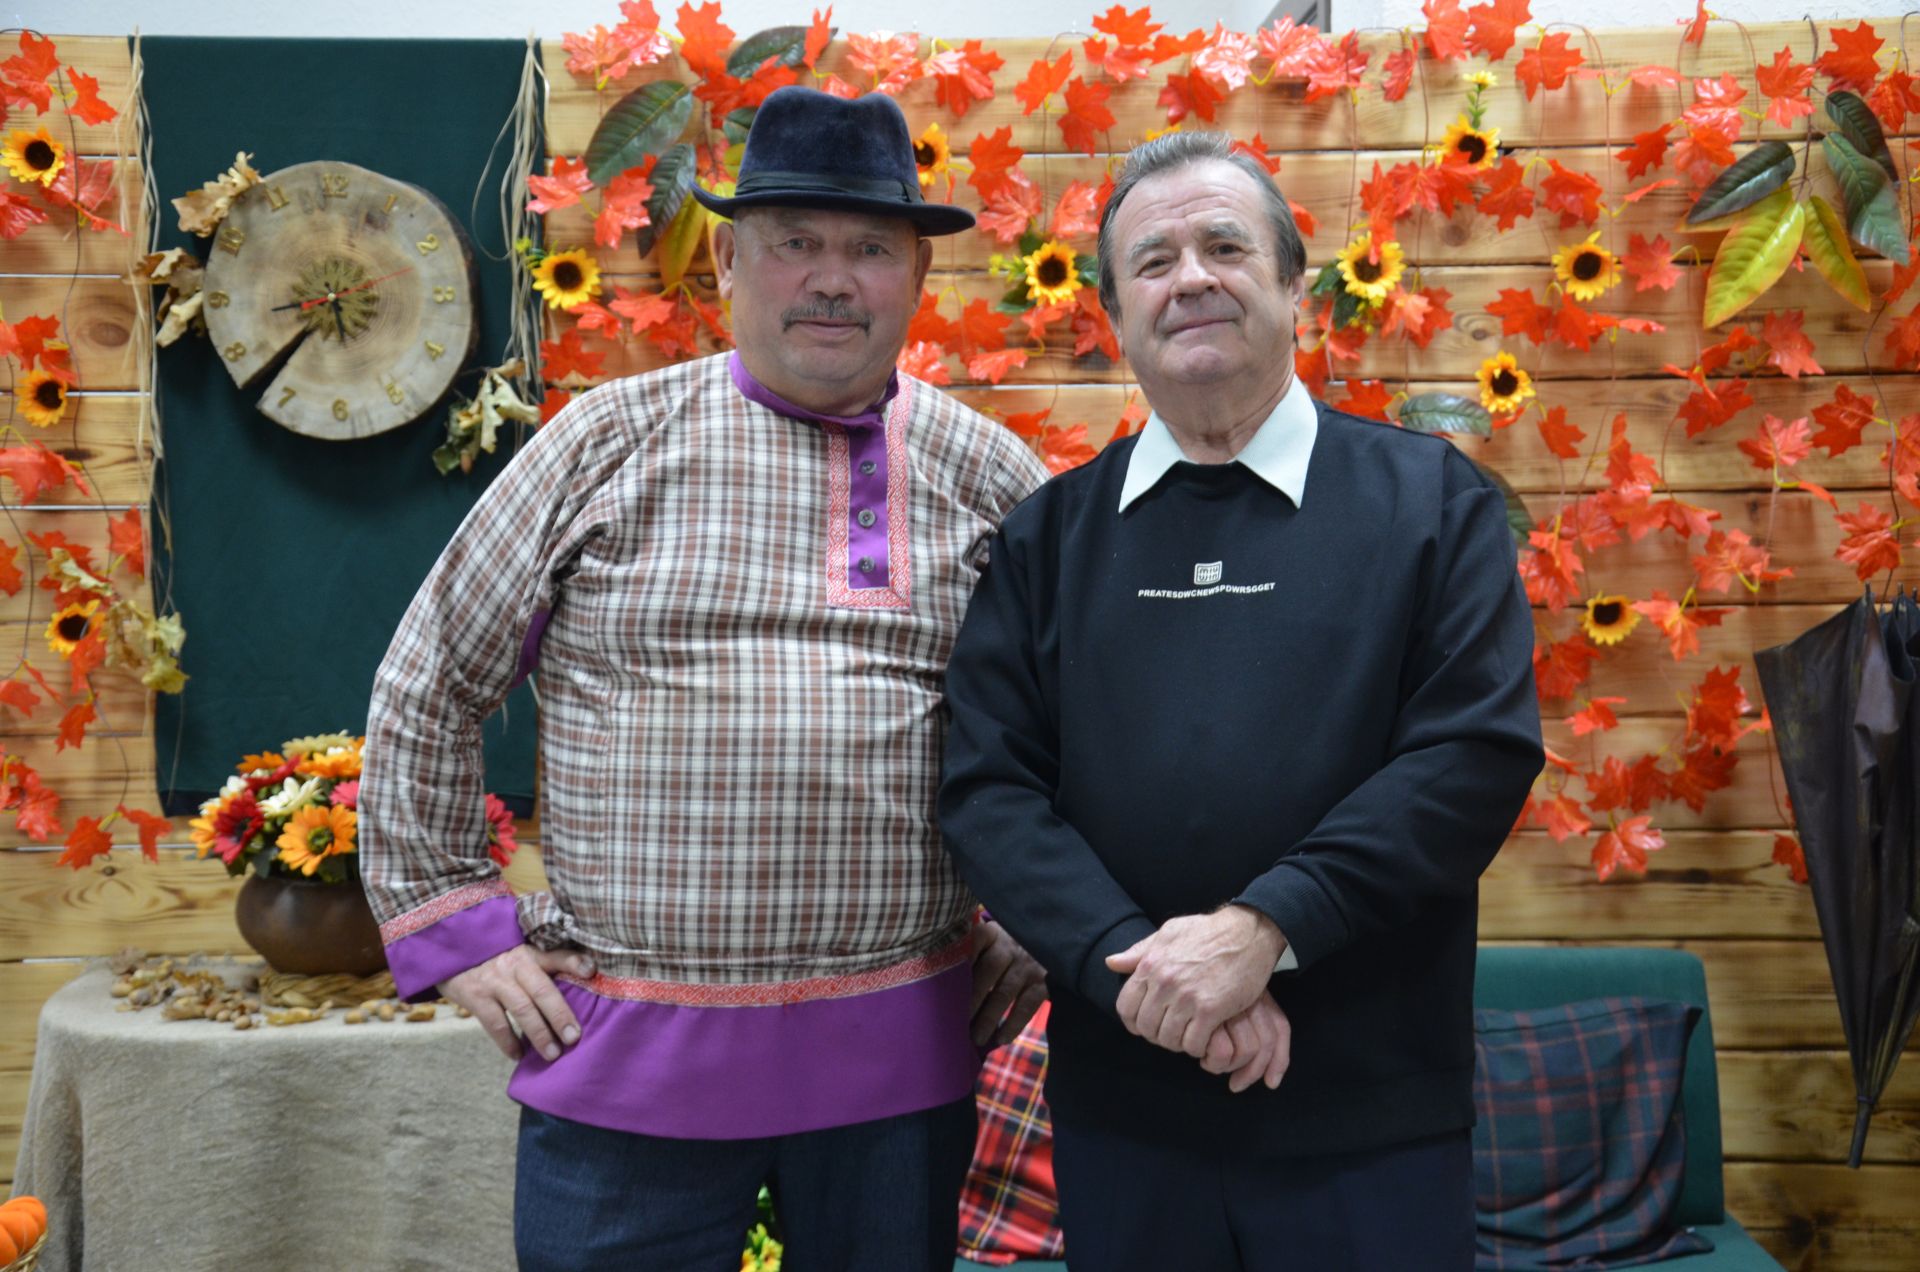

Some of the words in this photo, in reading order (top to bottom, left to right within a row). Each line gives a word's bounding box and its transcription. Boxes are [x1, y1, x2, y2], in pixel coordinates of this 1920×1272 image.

[323, 173, 348, 198] 12
[264, 186, 290, 212] 11
[383, 194, 398, 213] 1
[218, 228, 246, 257] 10
[416, 234, 438, 256] 2
[208, 290, 230, 309] 9
[434, 287, 455, 304] 3
[225, 342, 246, 362] 8
[424, 340, 444, 361] 4
[278, 386, 295, 408] 7
[386, 382, 404, 405] 5
[332, 399, 348, 421] 6
